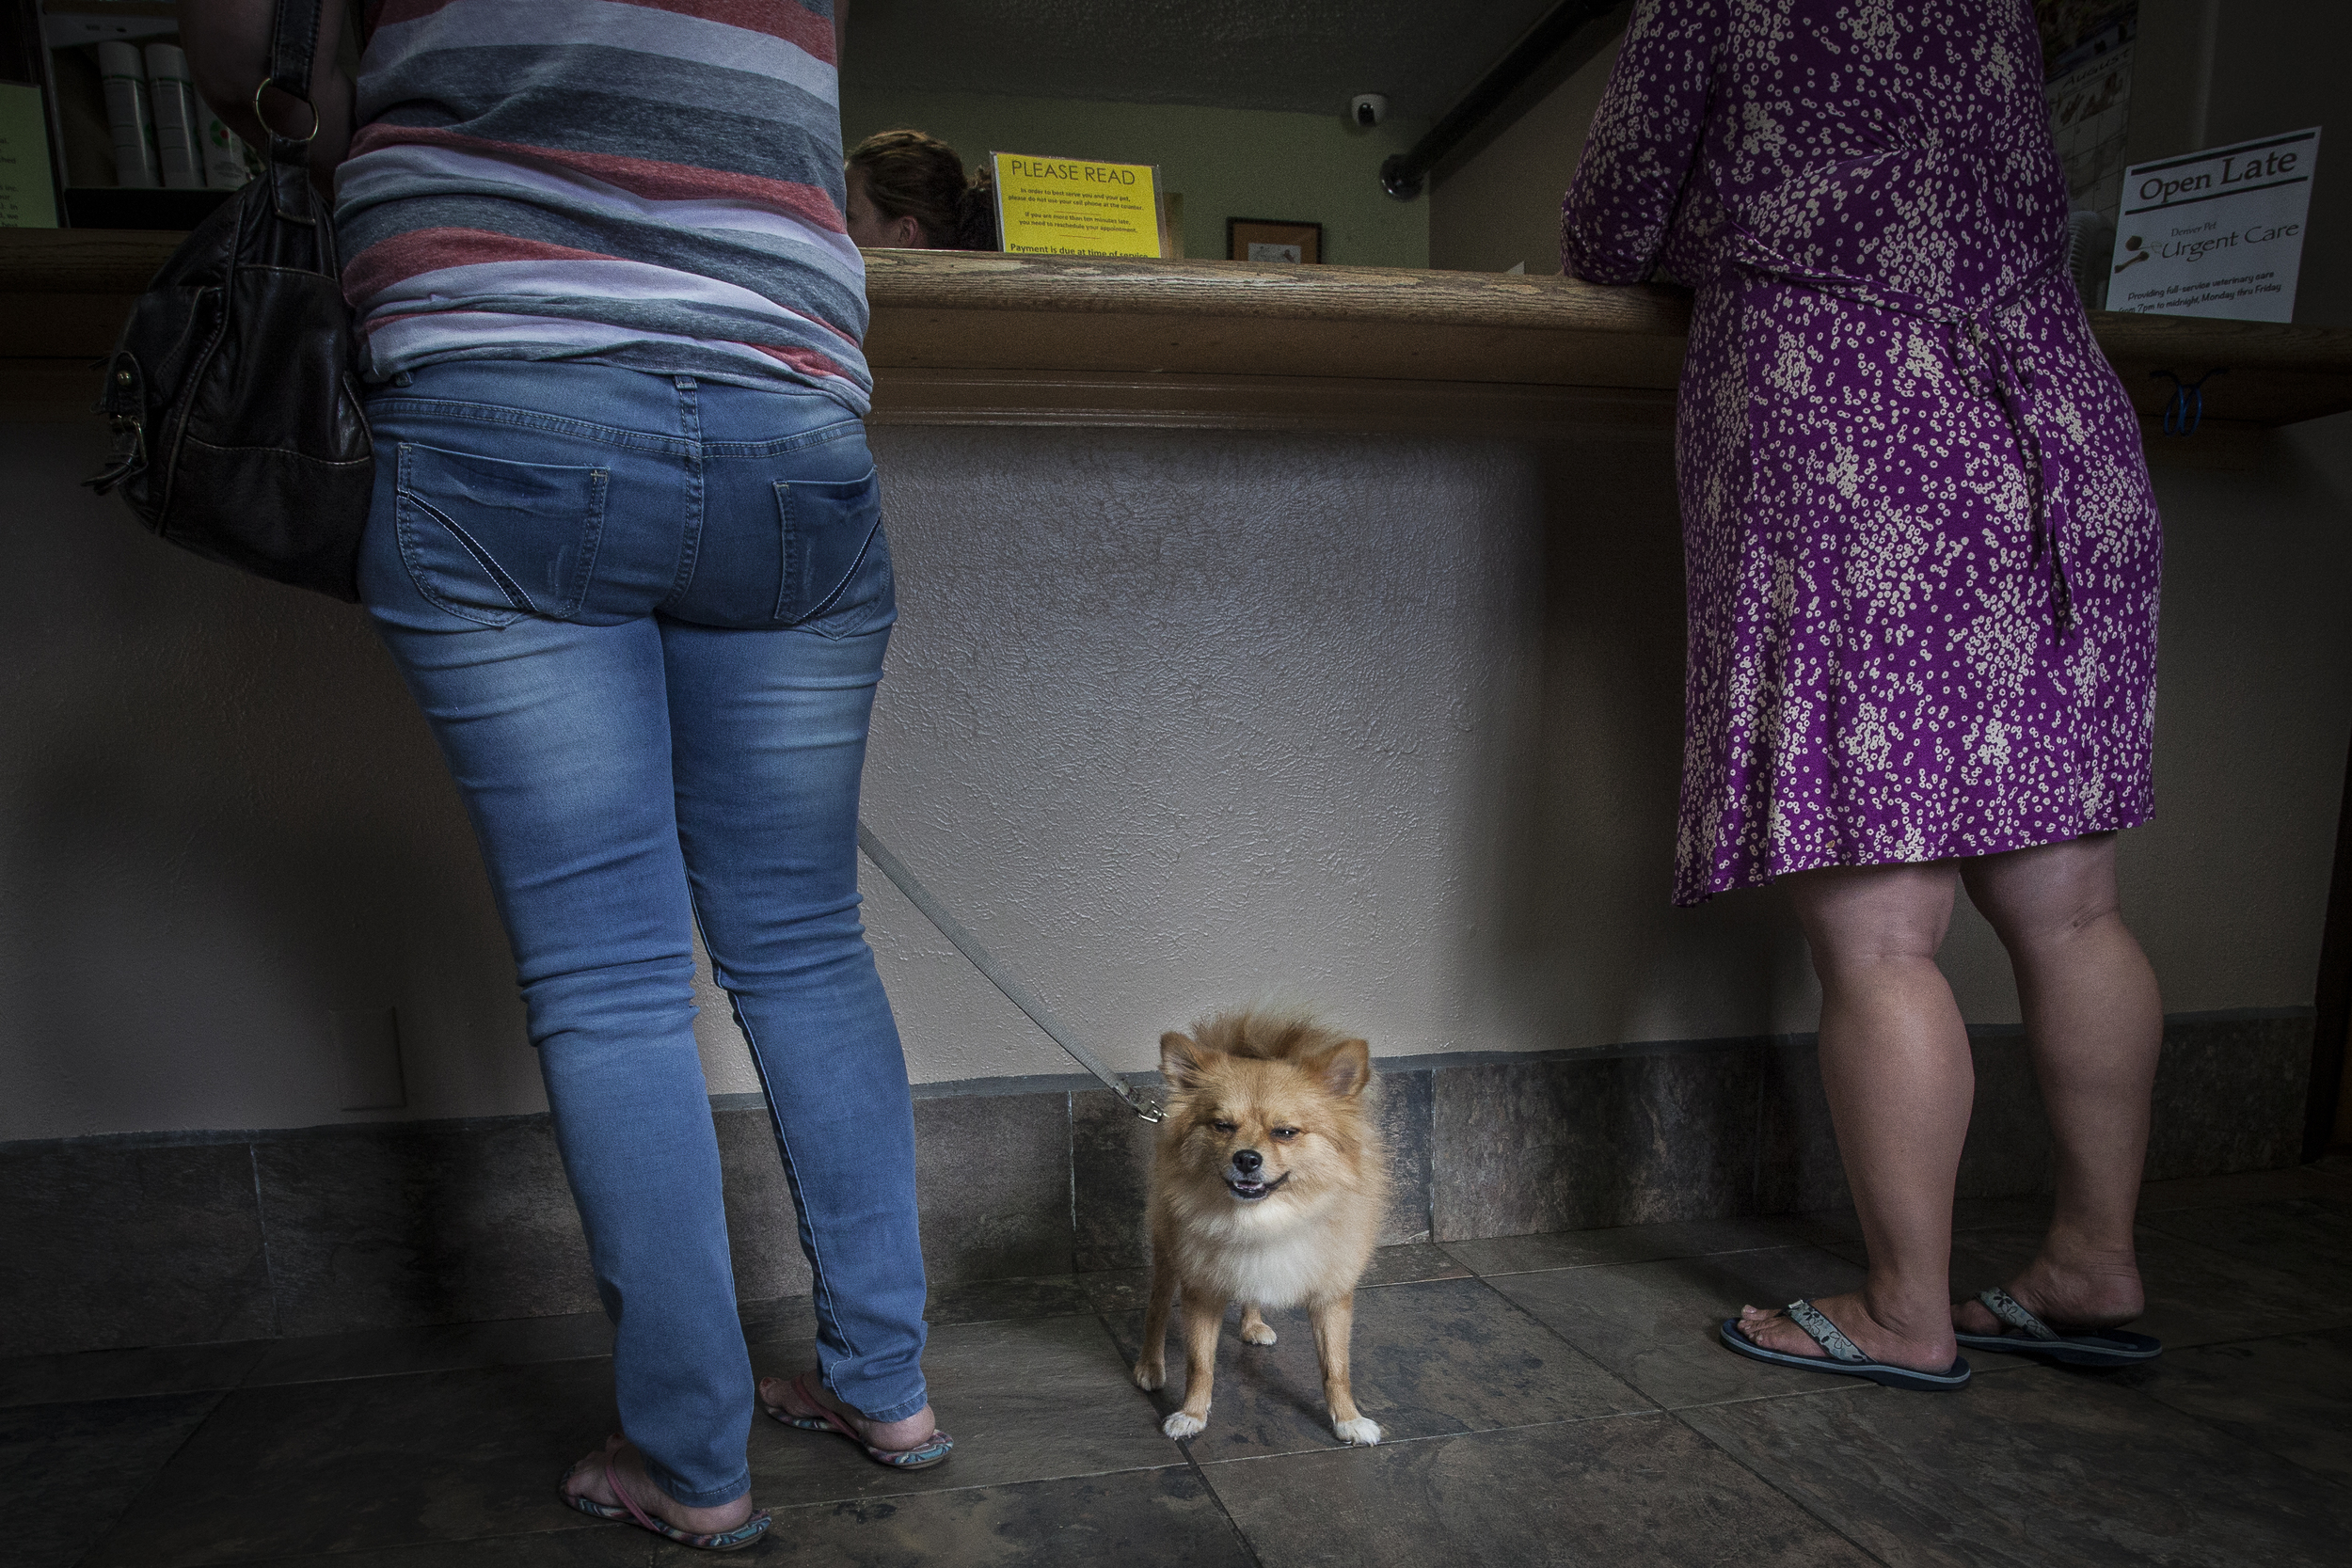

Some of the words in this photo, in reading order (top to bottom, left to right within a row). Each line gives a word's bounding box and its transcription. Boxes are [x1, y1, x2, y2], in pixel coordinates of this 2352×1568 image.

[1012, 160, 1078, 181] PLEASE
[1085, 166, 1135, 185] READ
[2139, 173, 2211, 203] Open
[2220, 150, 2297, 185] Late
[2162, 232, 2239, 261] Urgent
[2245, 224, 2299, 244] Care
[2171, 227, 2201, 237] Denver
[2202, 222, 2217, 231] Pet
[1010, 244, 1048, 253] Payment
[2128, 290, 2164, 301] Providing
[2167, 280, 2211, 294] full-service
[2213, 276, 2253, 287] veterinary
[2256, 271, 2275, 279] care
[2137, 304, 2154, 313] 7pm
[2166, 295, 2200, 308] midnight,
[2201, 292, 2234, 303] Monday
[2236, 288, 2252, 297] thru
[2255, 283, 2281, 294] Friday
